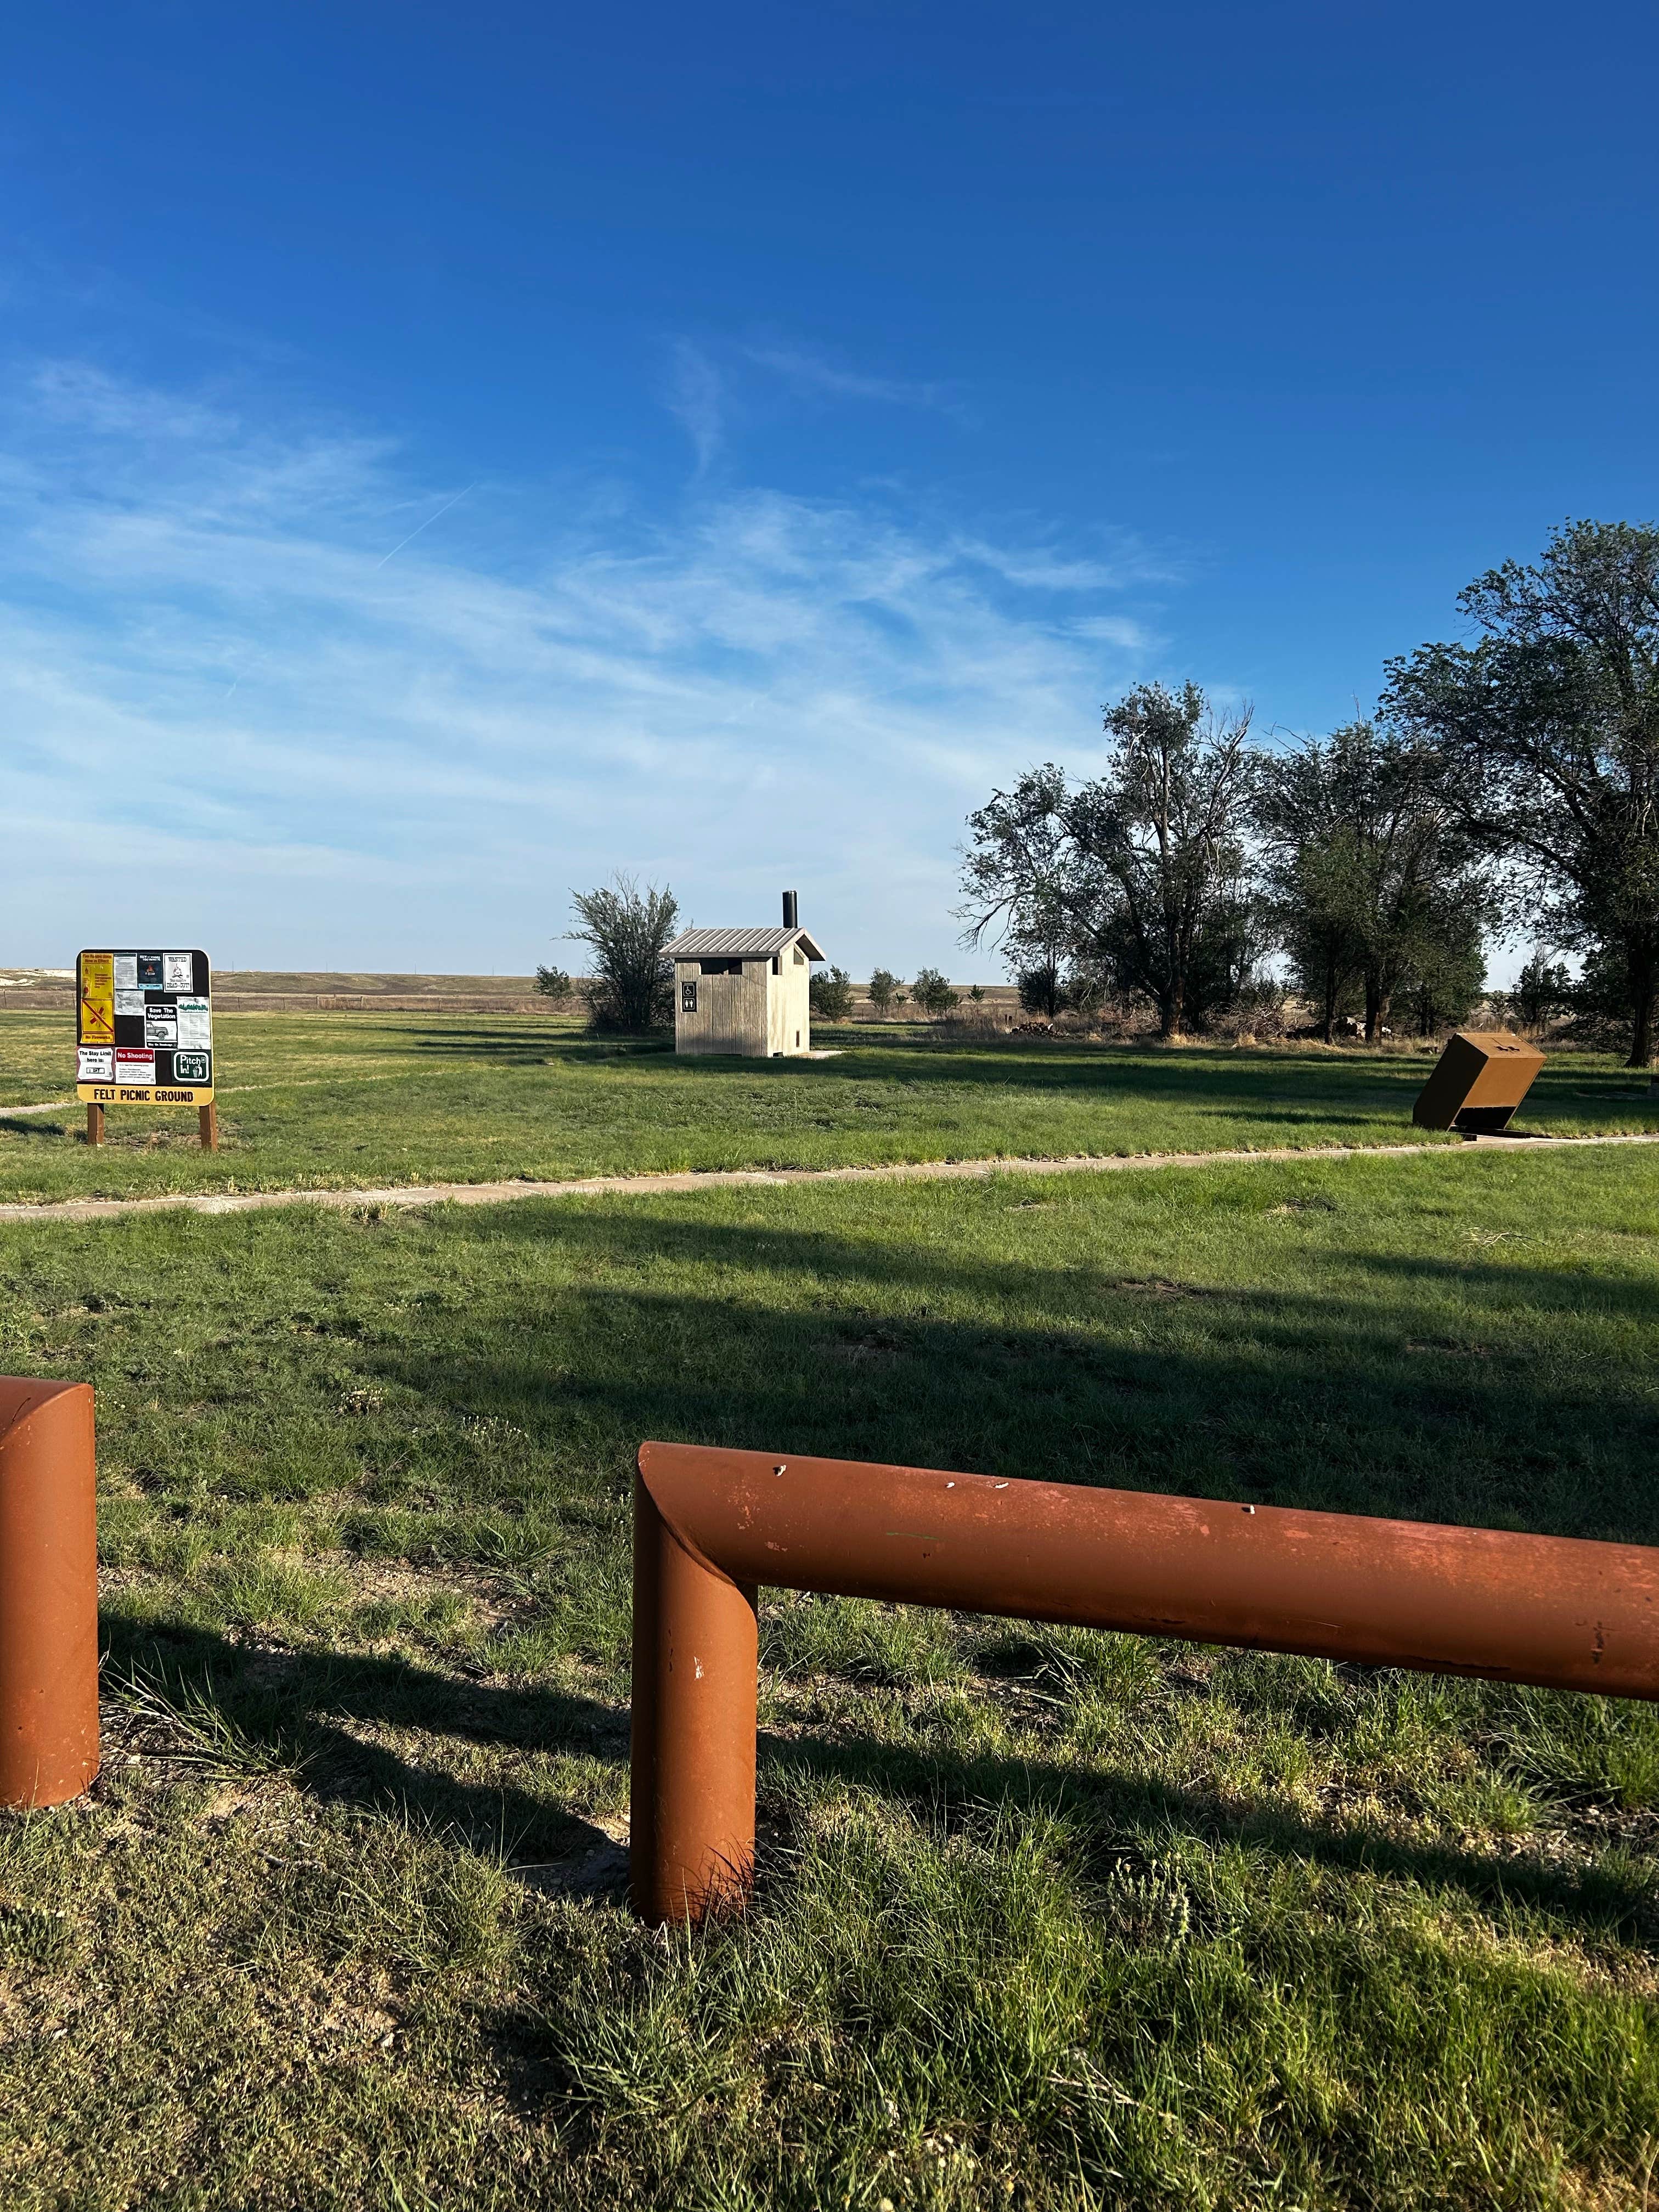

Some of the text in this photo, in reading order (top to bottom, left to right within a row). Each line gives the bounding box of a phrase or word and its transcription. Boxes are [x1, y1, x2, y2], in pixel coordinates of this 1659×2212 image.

[180, 1054, 201, 1065] Pitch
[180, 1064, 189, 1074] In!
[94, 1088, 194, 1102] FELT PICNIC GROUND
